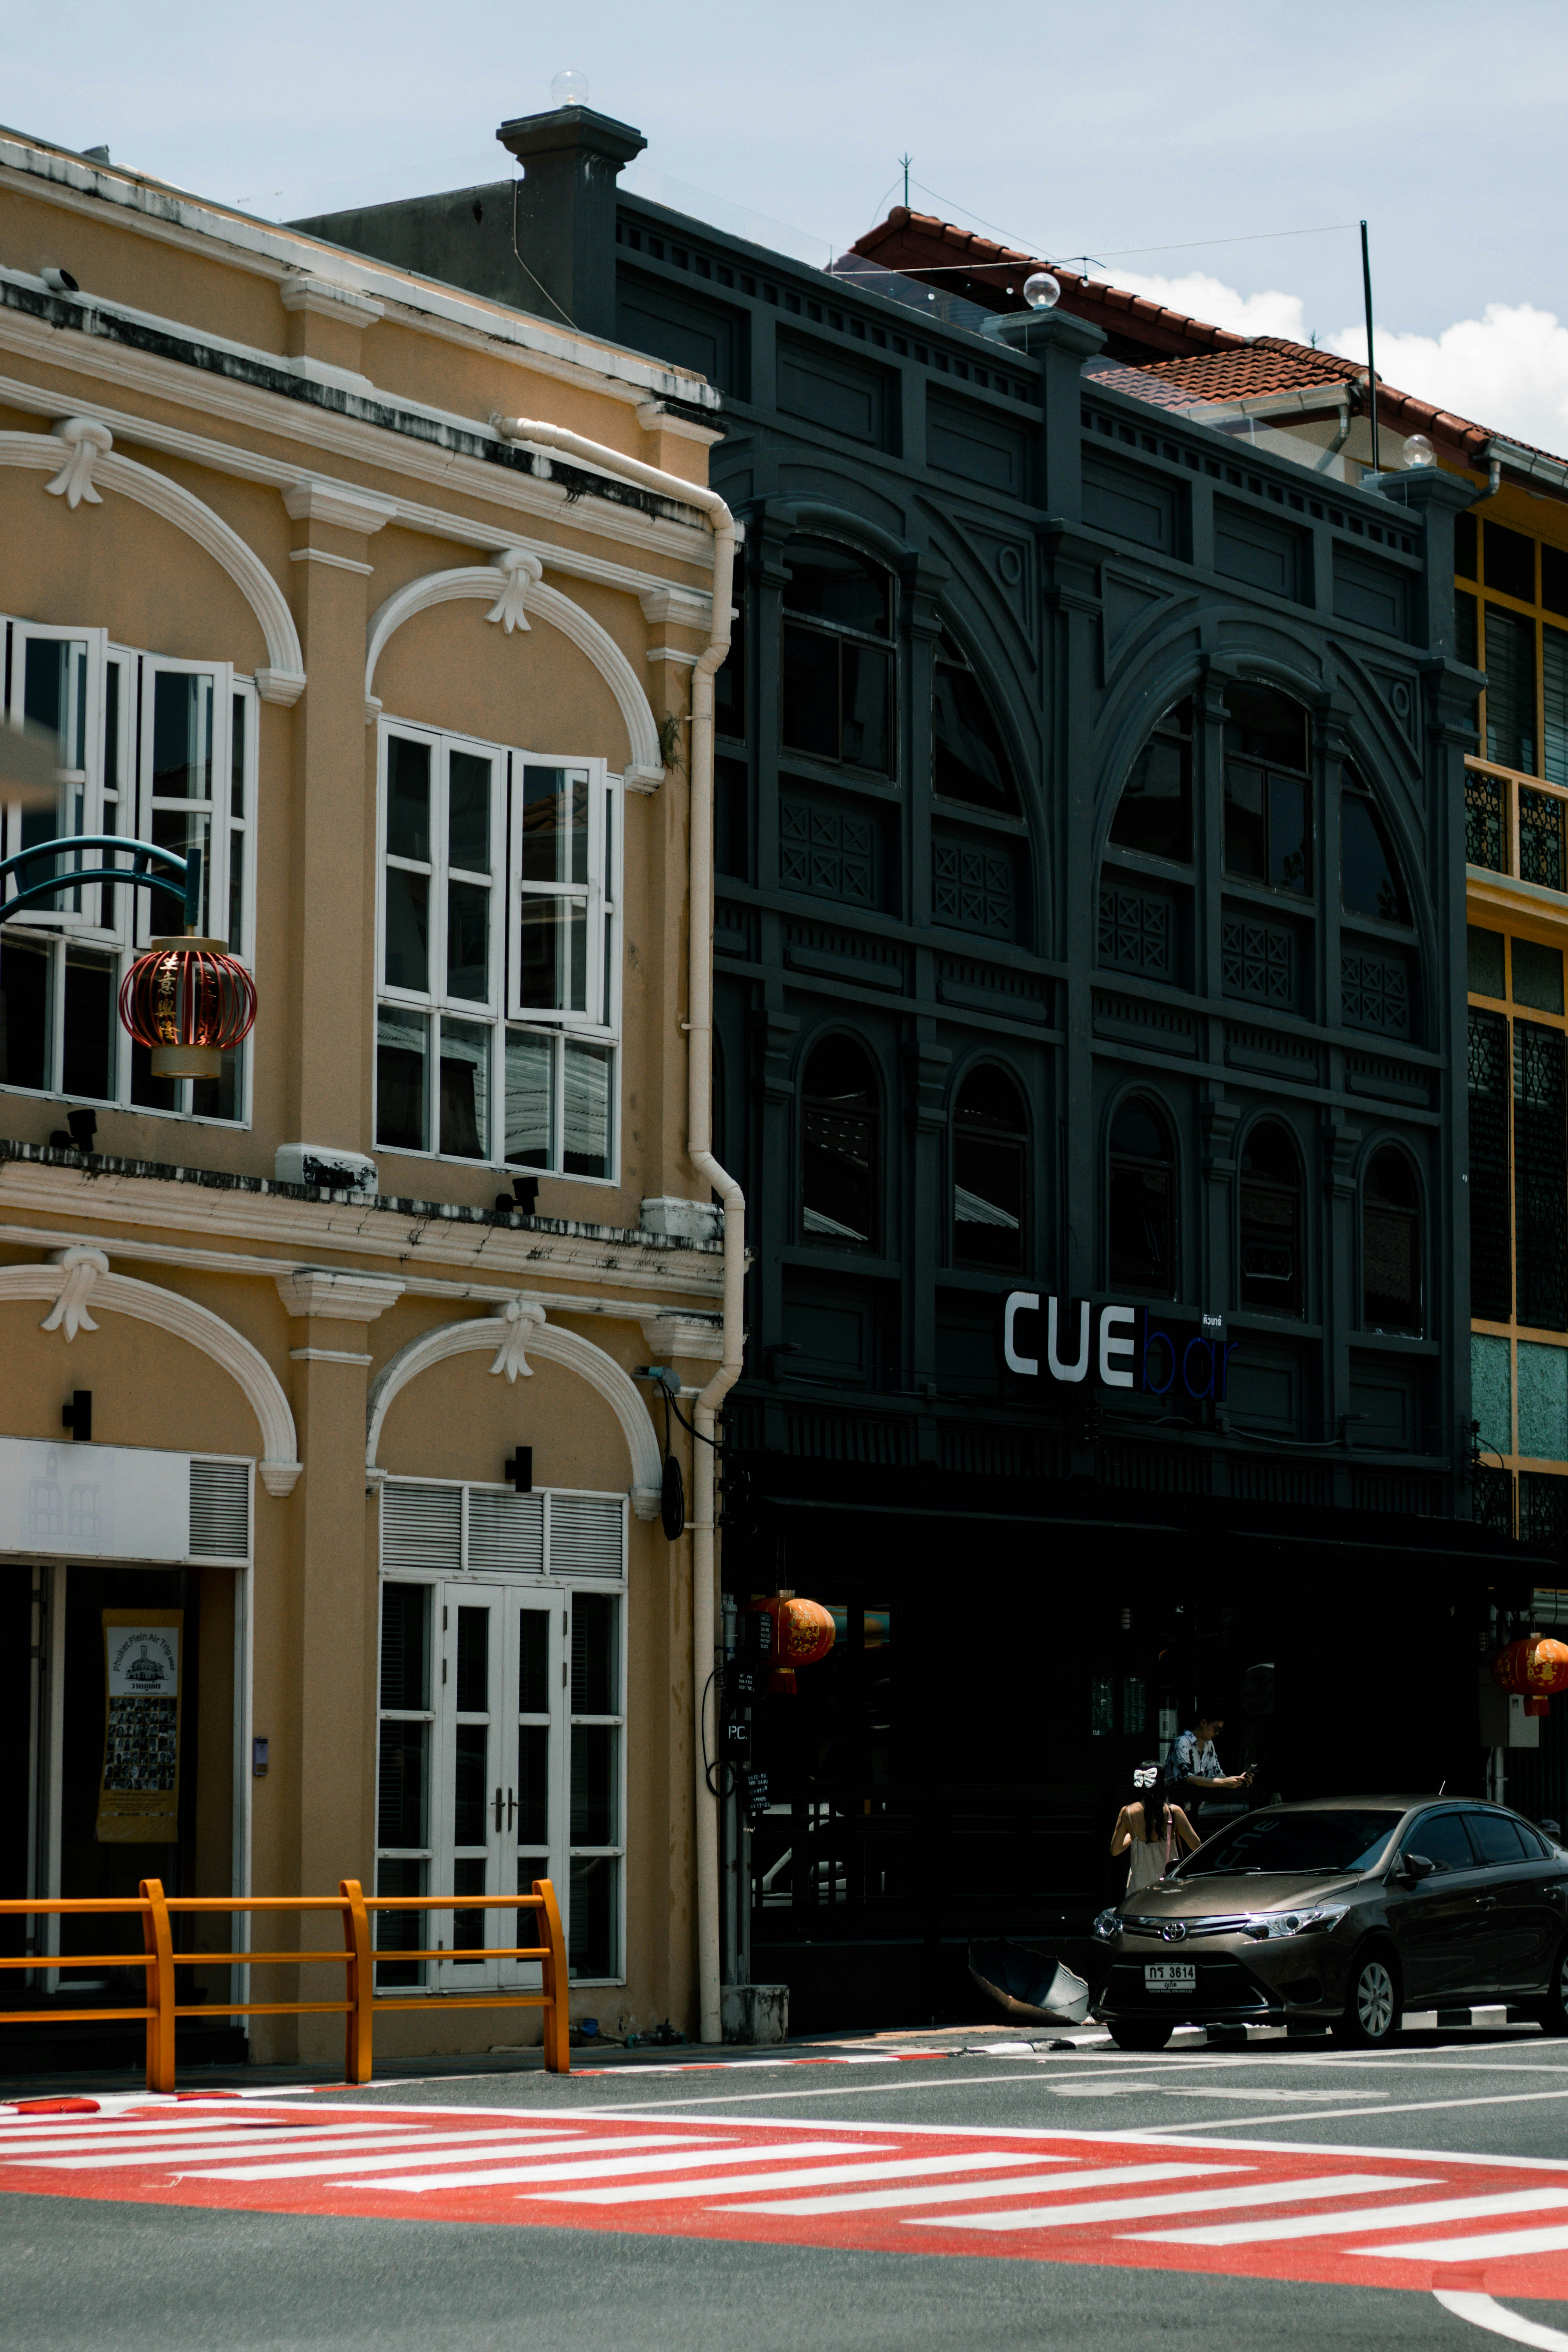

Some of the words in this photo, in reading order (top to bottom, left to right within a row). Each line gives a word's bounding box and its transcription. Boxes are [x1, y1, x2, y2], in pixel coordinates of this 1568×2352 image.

[113, 1641, 131, 1672] Phuket
[128, 1633, 147, 1645] Plein
[148, 1633, 160, 1644] Air
[160, 1638, 171, 1657] Trip
[728, 1725, 748, 1740] P.C.
[1149, 1967, 1164, 1978] กร
[1169, 1967, 1194, 1978] 3614
[1164, 1981, 1177, 1989] ภูเก็ต
